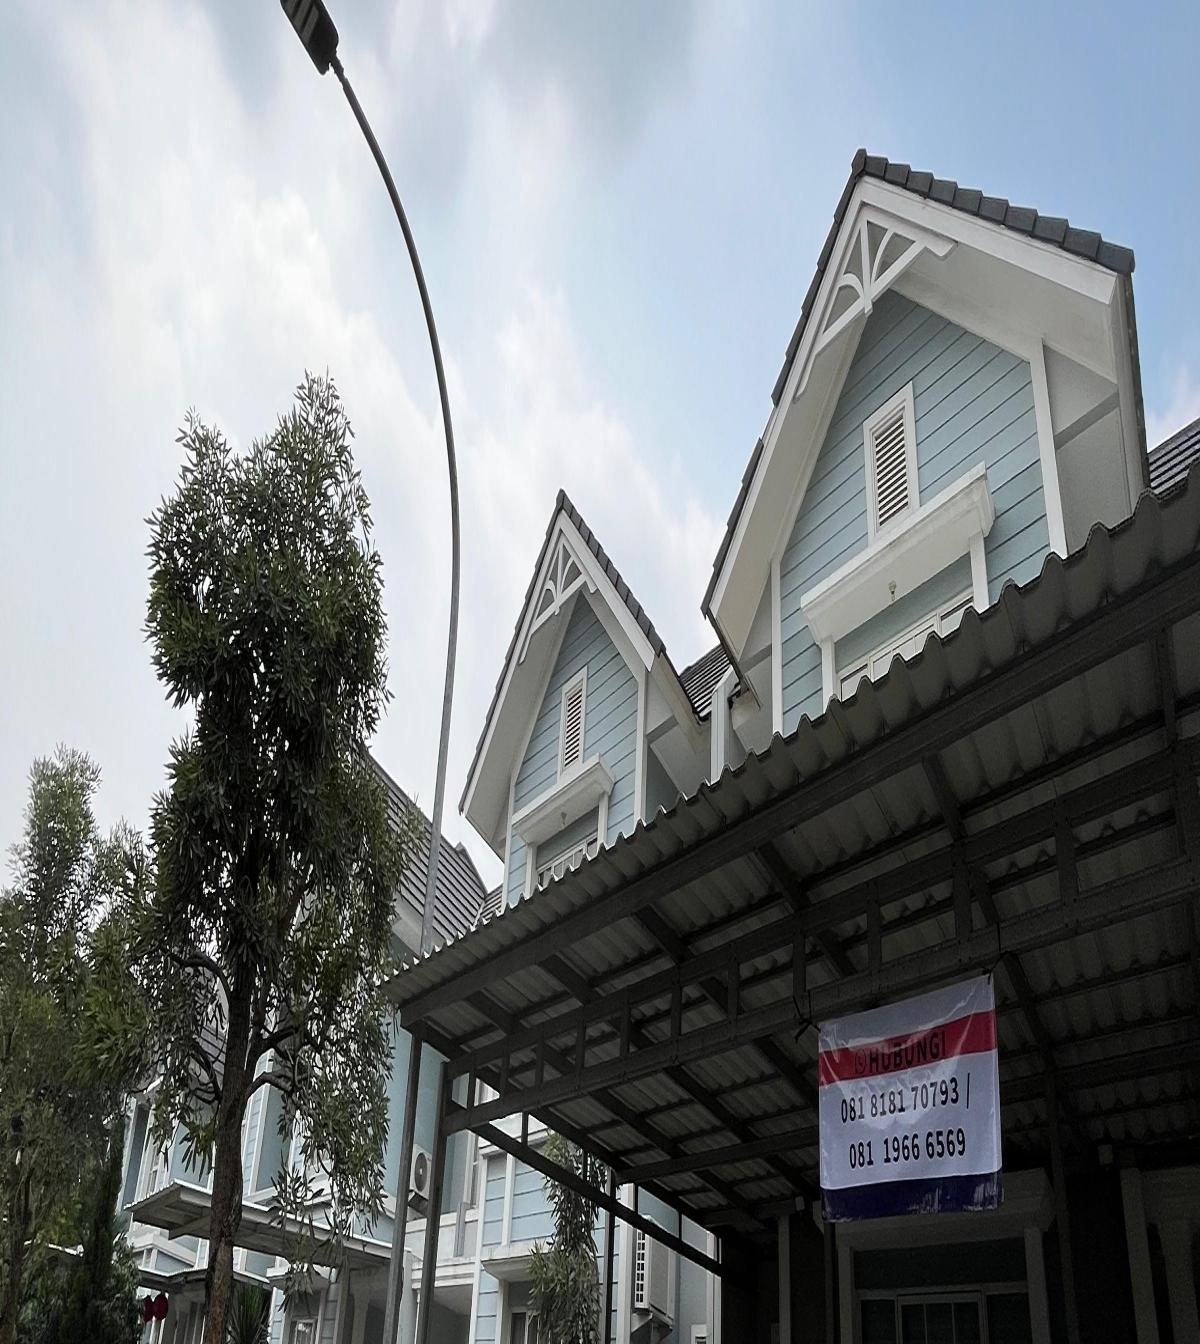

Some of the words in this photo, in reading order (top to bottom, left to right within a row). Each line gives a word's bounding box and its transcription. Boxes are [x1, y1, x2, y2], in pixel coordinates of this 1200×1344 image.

[869, 1031, 946, 1074] HUBUNGI
[841, 1097, 865, 1123] 081
[870, 1089, 906, 1118] 8181
[911, 1077, 959, 1110] 70793
[849, 1140, 874, 1169] 081
[883, 1133, 920, 1163] 1966
[925, 1128, 966, 1159] 6569
